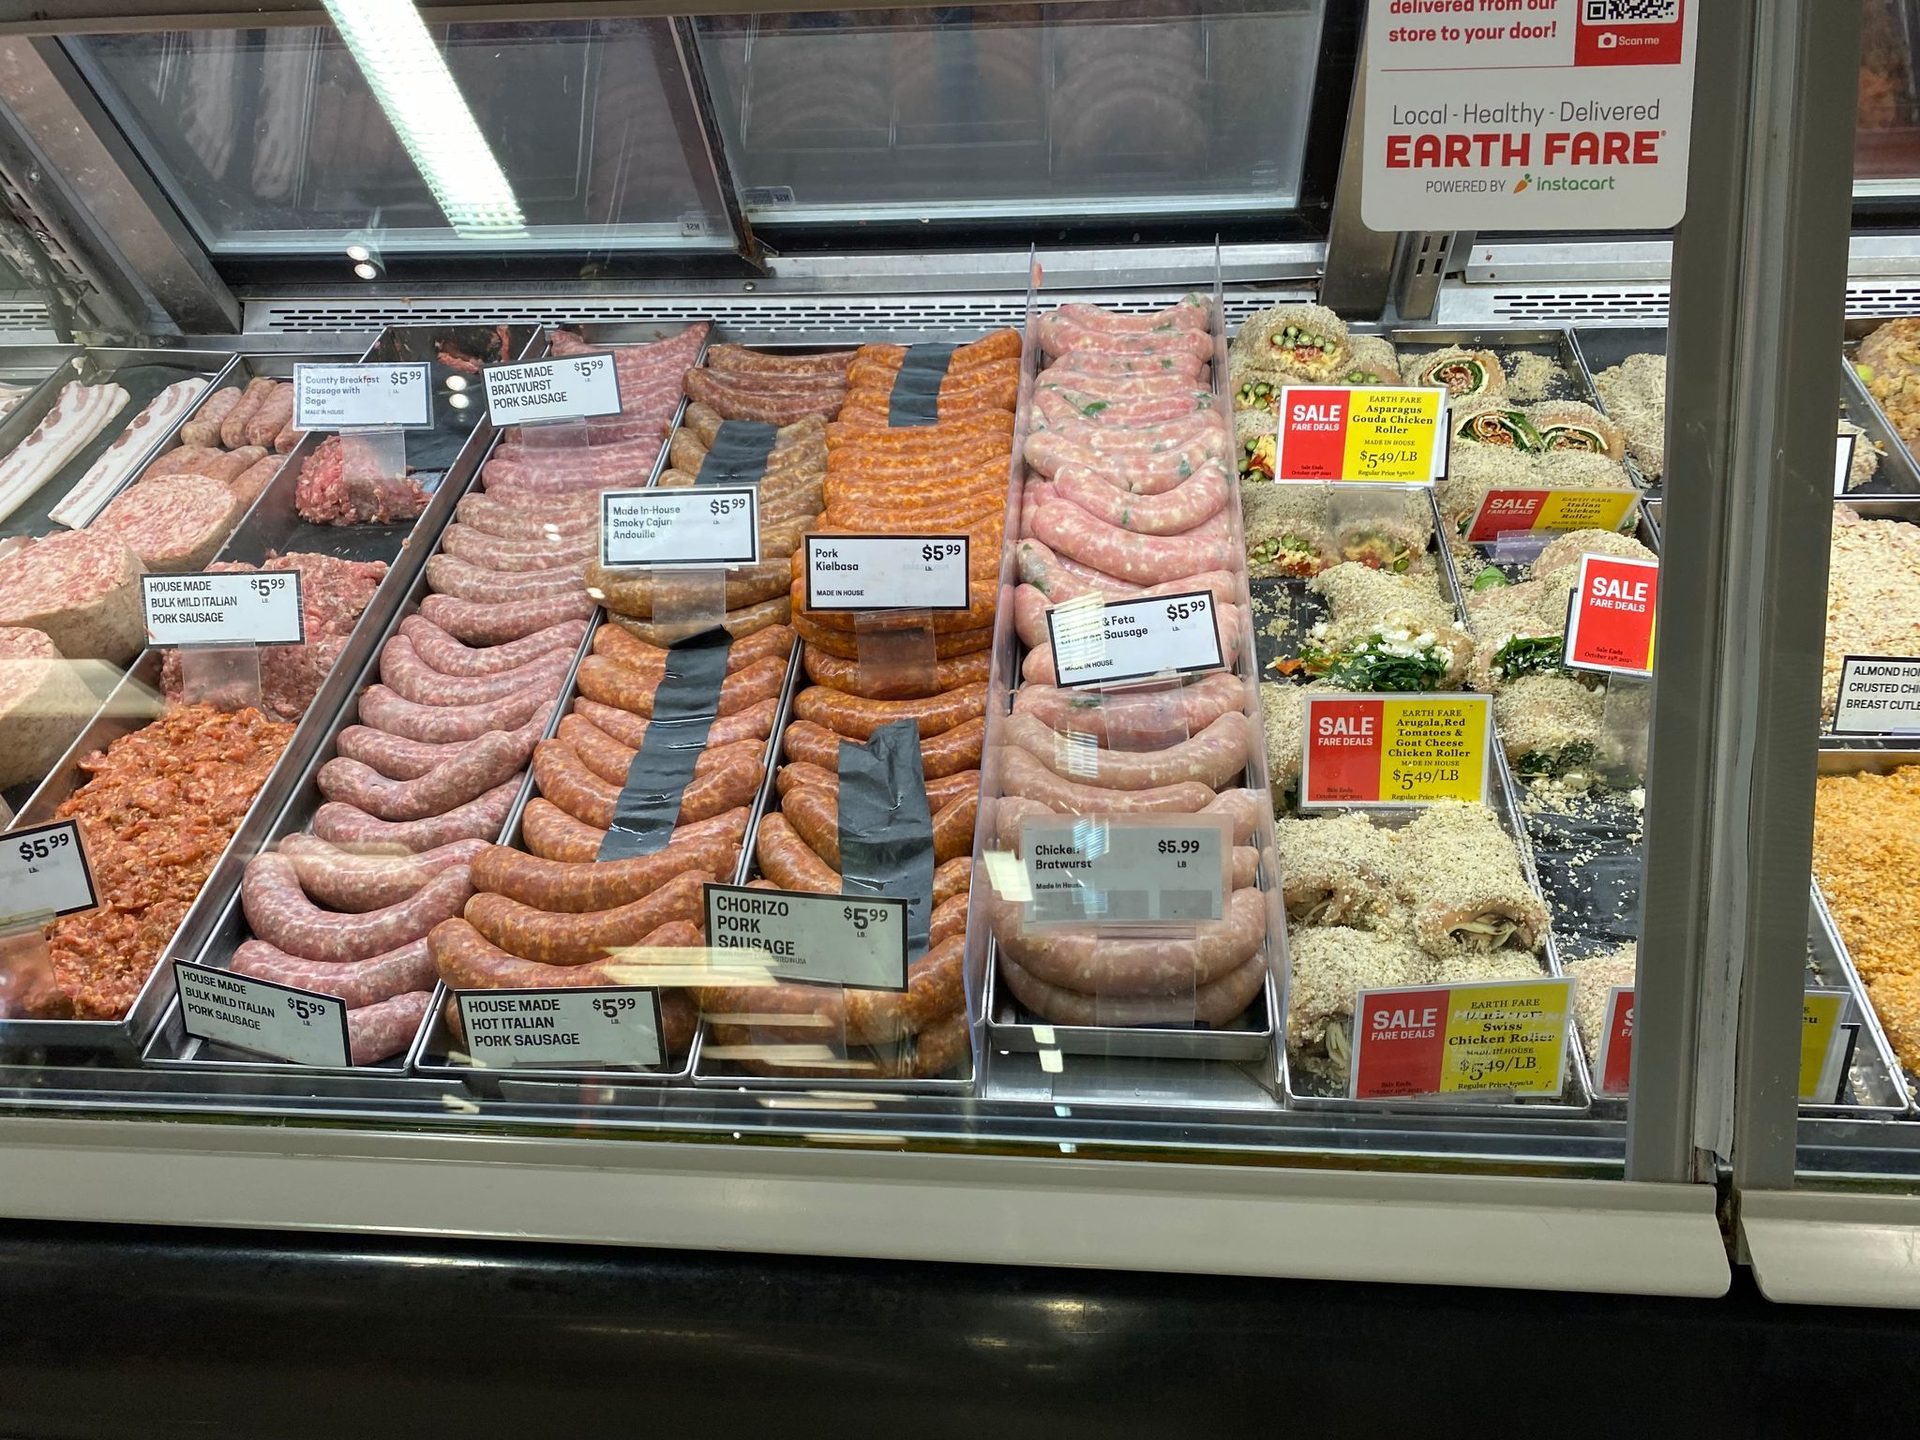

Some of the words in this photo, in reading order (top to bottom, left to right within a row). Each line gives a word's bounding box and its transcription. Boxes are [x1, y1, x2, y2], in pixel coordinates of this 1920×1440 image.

[1390, 0, 1474, 14] delivered
[1479, 0, 1522, 12] from
[1527, 0, 1557, 11] our
[1389, 27, 1437, 42] store
[1441, 26, 1460, 41] to
[1464, 27, 1506, 44] your
[1509, 21, 1557, 39] door!
[1618, 36, 1643, 46] Scan
[1645, 36, 1660, 46] me
[1393, 104, 1447, 125] Local
[1463, 101, 1545, 127] Healthy
[1559, 99, 1660, 123] Delivered
[1386, 132, 1531, 169] EARTH
[1544, 130, 1660, 167] FARE
[1425, 180, 1488, 193] POWERED
[1490, 180, 1506, 192] BY
[1536, 175, 1616, 192] instacart
[489, 369, 522, 383] HOUSE
[524, 365, 554, 378] MADE
[340, 375, 380, 385] Breakfast
[305, 387, 341, 396] Sausage
[342, 386, 361, 394] with
[491, 379, 552, 396] BRATWURST
[305, 397, 327, 406] Sage
[493, 396, 520, 410] PORK
[521, 391, 568, 407] SAUSAGE
[1293, 404, 1342, 422] SALE
[1366, 405, 1422, 415] Asparagus
[1352, 415, 1387, 424] Gouda
[1390, 415, 1433, 425] Chicken
[1292, 423, 1312, 431] FARE
[1313, 423, 1340, 431] DEALS
[1375, 426, 1408, 434] Roller
[1490, 498, 1539, 509] SALE
[613, 506, 639, 515] Made
[640, 505, 681, 515] In-House
[613, 518, 644, 528] Smoky
[646, 518, 673, 528] Cajun
[613, 530, 656, 539] Andouille
[815, 548, 838, 558] Pork
[815, 561, 859, 571] Kielbasa
[150, 582, 182, 593] HOUSE
[183, 581, 212, 592] MADE
[1592, 577, 1648, 602] SALE
[151, 598, 176, 608] BULK
[177, 597, 201, 607] MILD
[202, 596, 238, 607] ITALIAN
[1590, 597, 1614, 609] FARE
[1615, 601, 1646, 613] DEALS
[152, 614, 178, 624] PORK
[179, 612, 224, 623] SAUSAGE
[1102, 617, 1110, 627] &
[1111, 615, 1135, 626] Feta
[1104, 627, 1148, 640] Sausage
[1092, 659, 1113, 667] HOUSE
[1853, 666, 1900, 676] ALMOND
[1849, 683, 1899, 693] CRUSTED
[1846, 699, 1888, 709] BREAST
[1402, 709, 1434, 717] EARTH
[1437, 709, 1462, 717] FARE
[1319, 716, 1375, 735] SALE
[1397, 729, 1452, 737] Tomatoes
[1455, 728, 1463, 737] &
[1318, 737, 1342, 746] FARE
[1343, 737, 1373, 746] DEALS
[1396, 739, 1422, 747] Goat
[1424, 739, 1464, 747] Cheese
[1388, 749, 1433, 757] Chicken
[1436, 748, 1471, 757] Roller
[1391, 793, 1417, 801] Regular
[1158, 839, 1200, 854] $5.99
[1035, 859, 1092, 870] Bratwurst
[716, 896, 789, 917] CHORIZO
[717, 915, 761, 933] PORK
[718, 934, 795, 956] SAUSAGE
[182, 970, 216, 987] HOUSE
[217, 979, 247, 994] MADE
[185, 987, 213, 1002] BULK
[212, 994, 237, 1008] MILD
[238, 1002, 275, 1018] ITALIAN
[468, 1000, 516, 1013] HOUSE
[519, 999, 560, 1011] MADE
[1471, 1000, 1507, 1009] EARTH
[1512, 999, 1540, 1007] FARE
[188, 1003, 214, 1018] PORK
[215, 1010, 261, 1030] SAUSAGE
[1373, 1008, 1438, 1030] SALE
[472, 1018, 500, 1030] HOT
[502, 1016, 554, 1029] ITALIAN
[1483, 1022, 1522, 1032] Swiss
[475, 1035, 512, 1047] PORK
[514, 1033, 580, 1046] SAUSAGE
[1371, 1032, 1398, 1041] FARE
[1401, 1030, 1436, 1040] DEALS
[1449, 1035, 1505, 1046] Chicken
[1458, 1082, 1486, 1090] Regular
